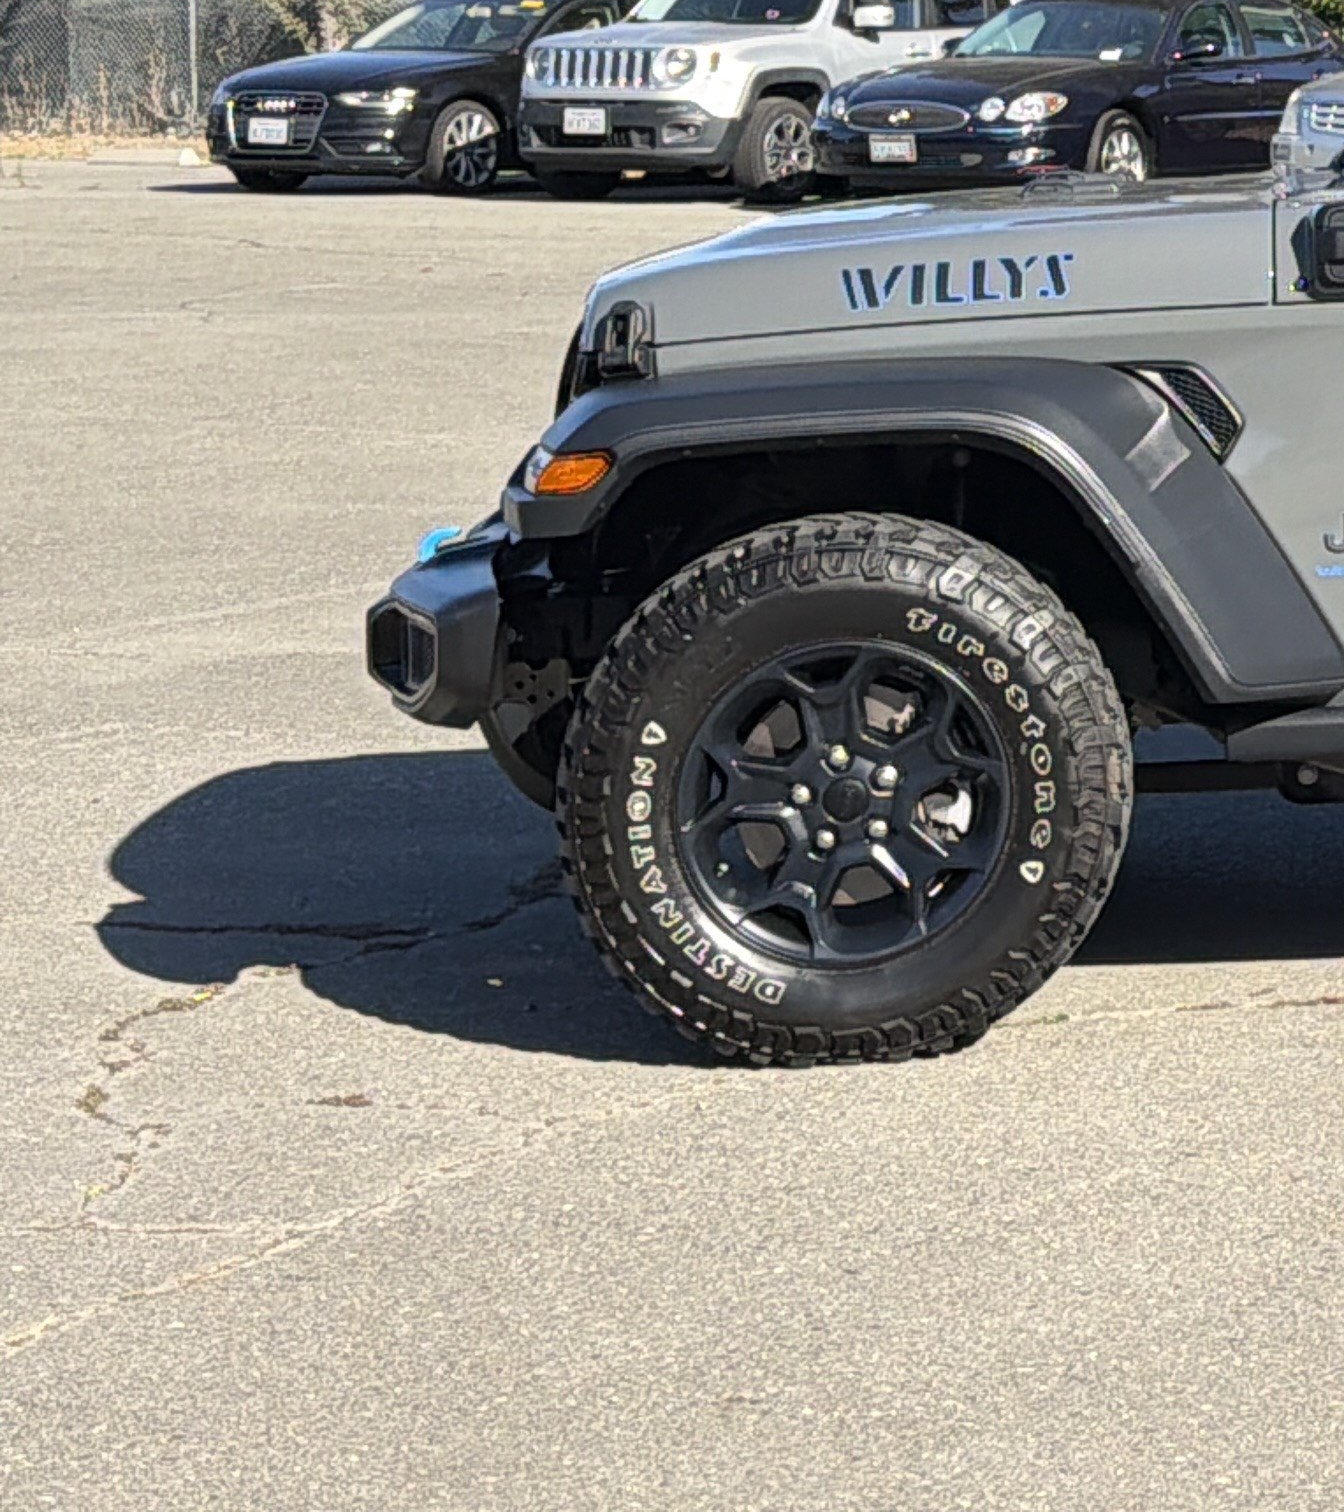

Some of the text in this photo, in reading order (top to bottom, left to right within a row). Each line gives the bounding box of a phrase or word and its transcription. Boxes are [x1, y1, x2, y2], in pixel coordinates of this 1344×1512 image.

[841, 252, 1075, 311] WILLYS
[905, 606, 1057, 850] Firestone
[626, 754, 787, 1006] DESTINATION
